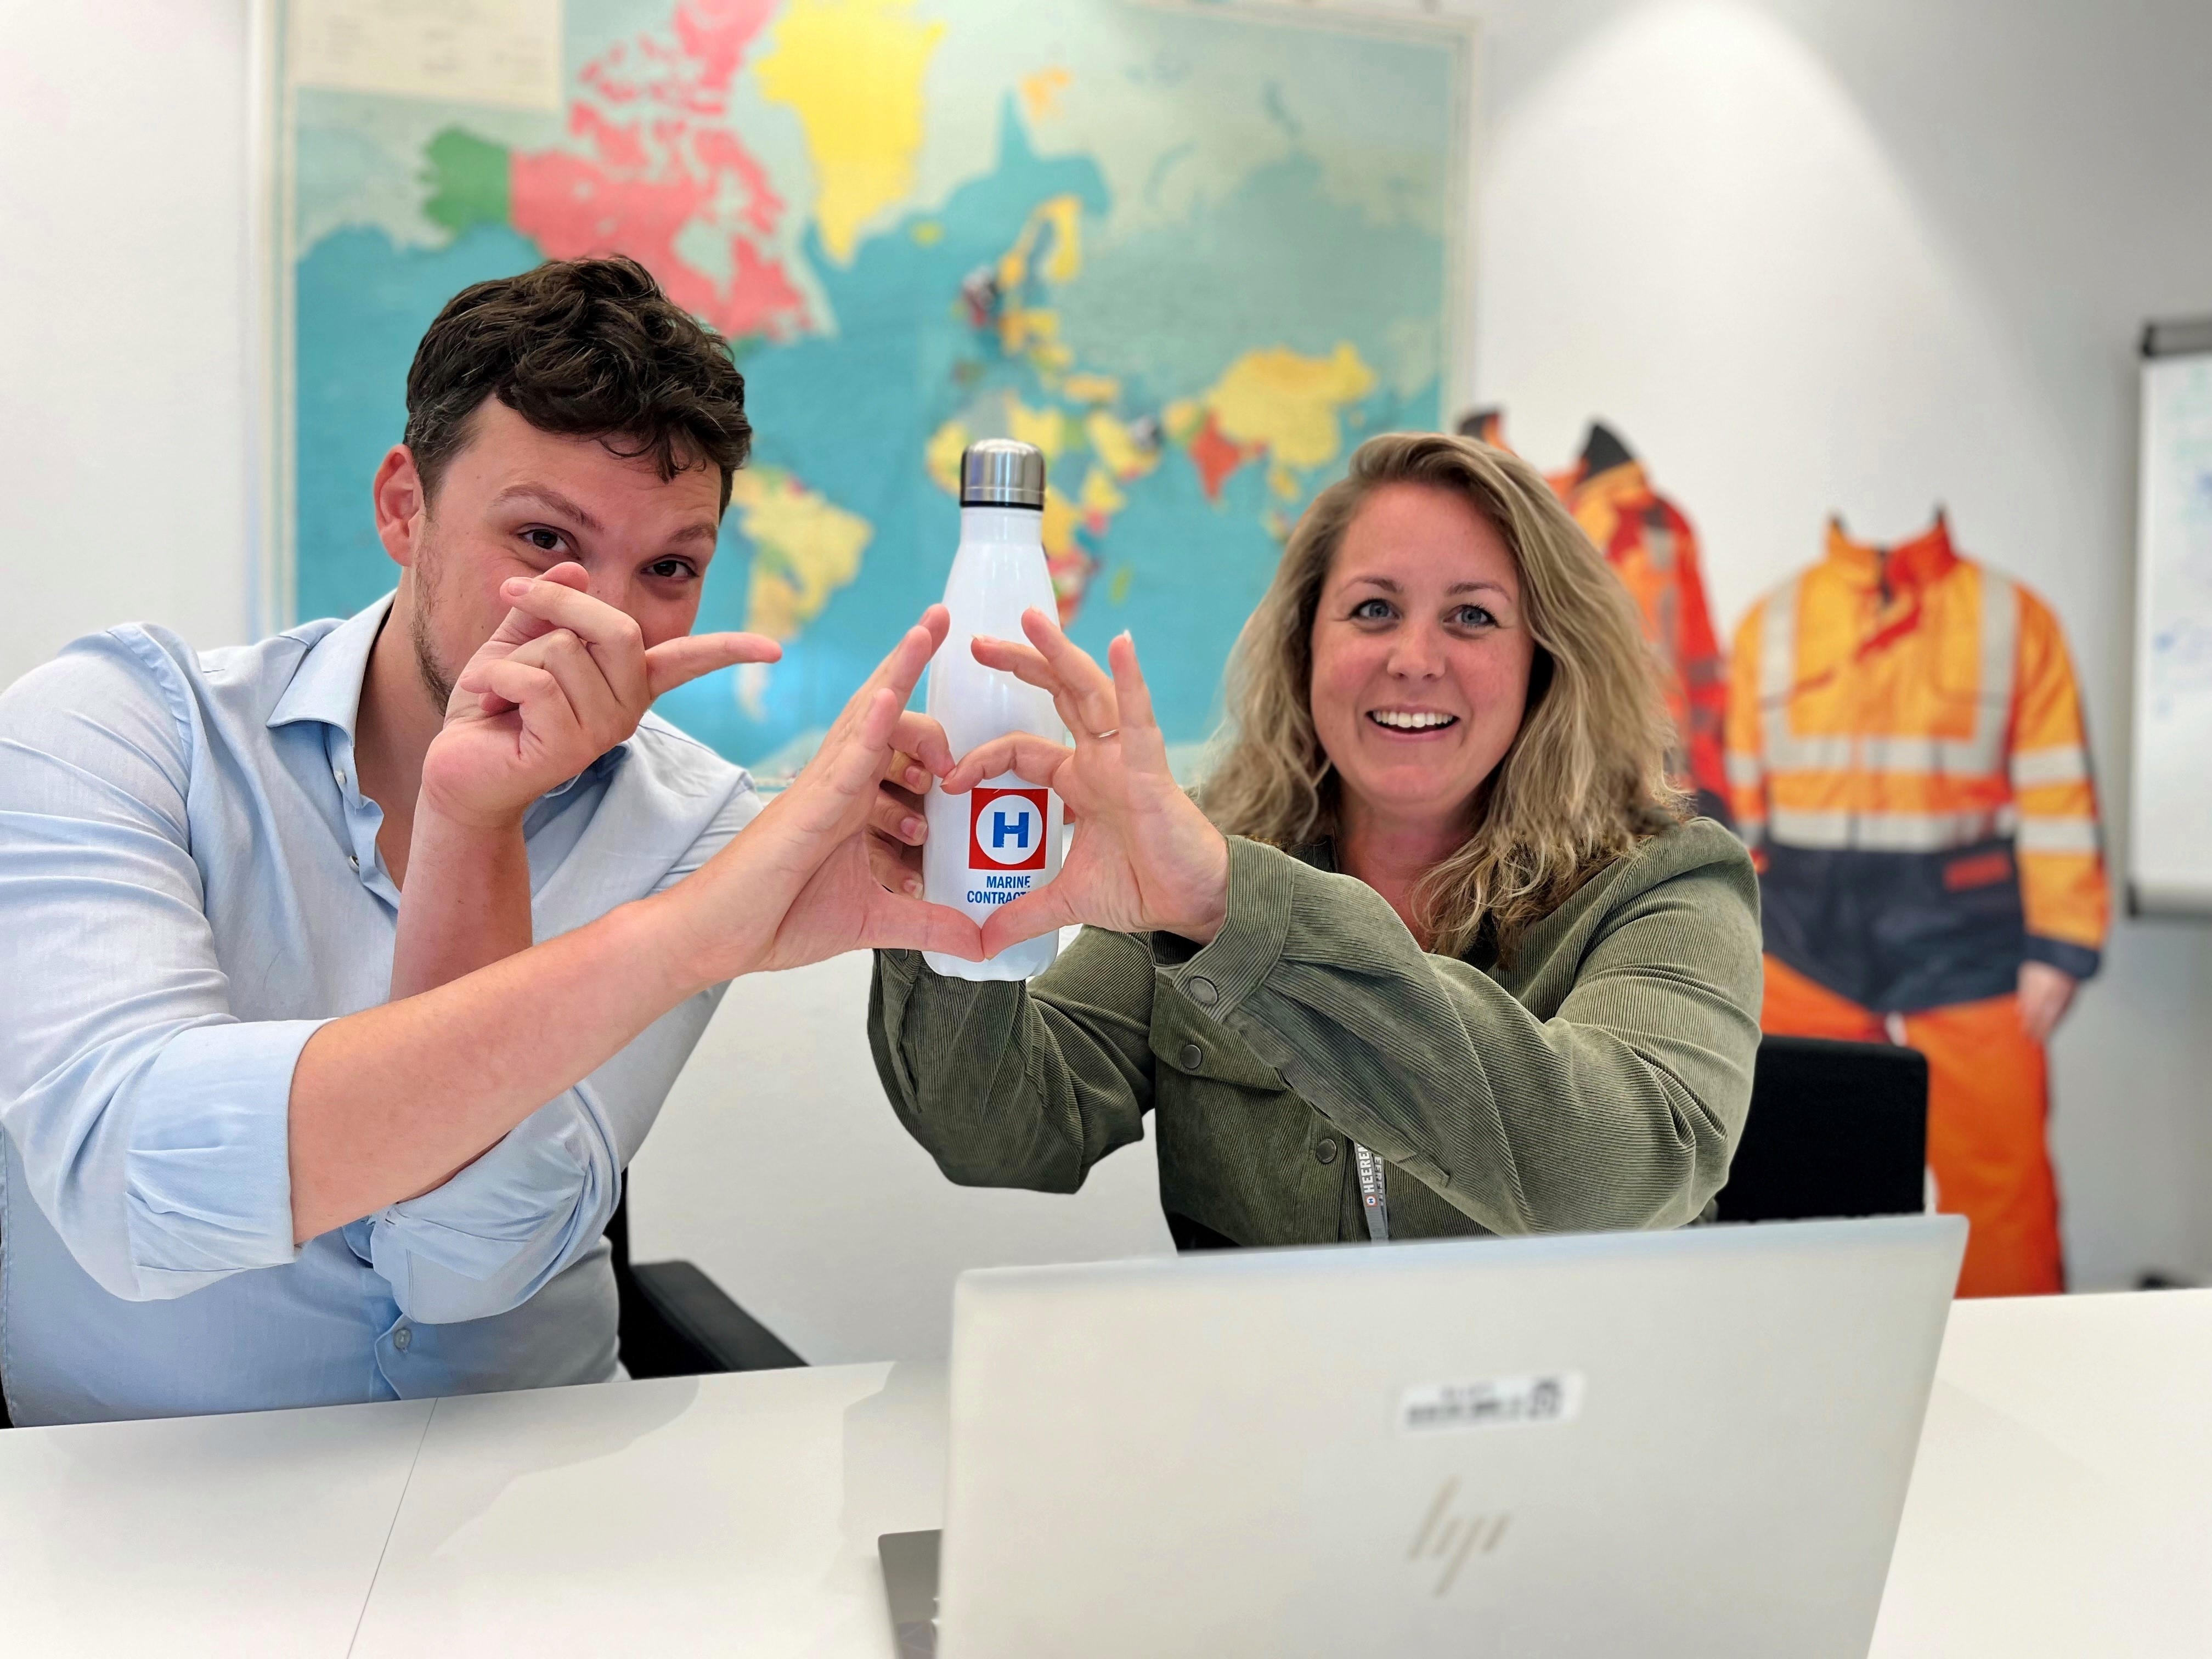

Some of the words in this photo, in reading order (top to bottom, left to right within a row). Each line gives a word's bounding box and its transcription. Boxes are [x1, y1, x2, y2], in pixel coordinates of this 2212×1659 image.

[992, 811, 1029, 848] H
[986, 876, 1031, 888] MARINE
[967, 890, 1030, 905] CONTRAC
